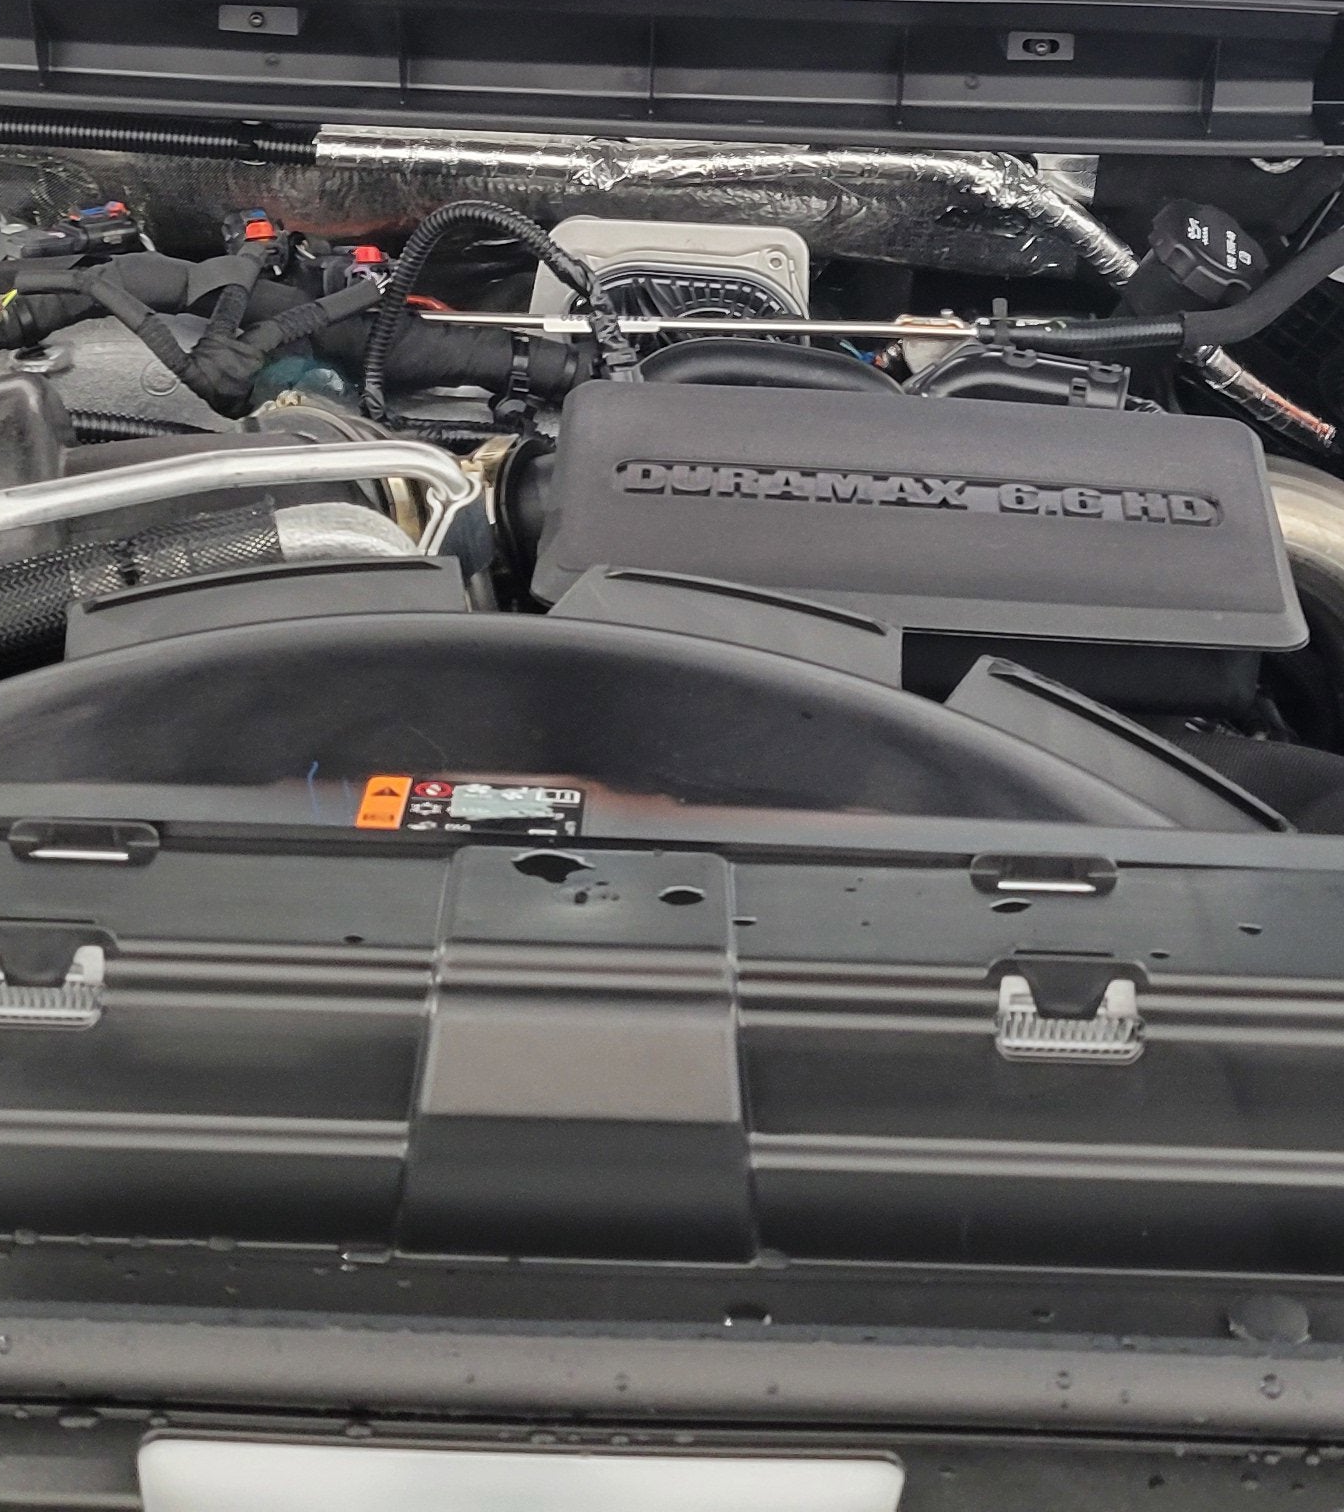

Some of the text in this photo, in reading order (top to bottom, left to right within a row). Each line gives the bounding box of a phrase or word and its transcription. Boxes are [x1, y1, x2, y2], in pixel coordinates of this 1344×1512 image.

[623, 463, 1219, 527] DURAMAX 6.6 HD
